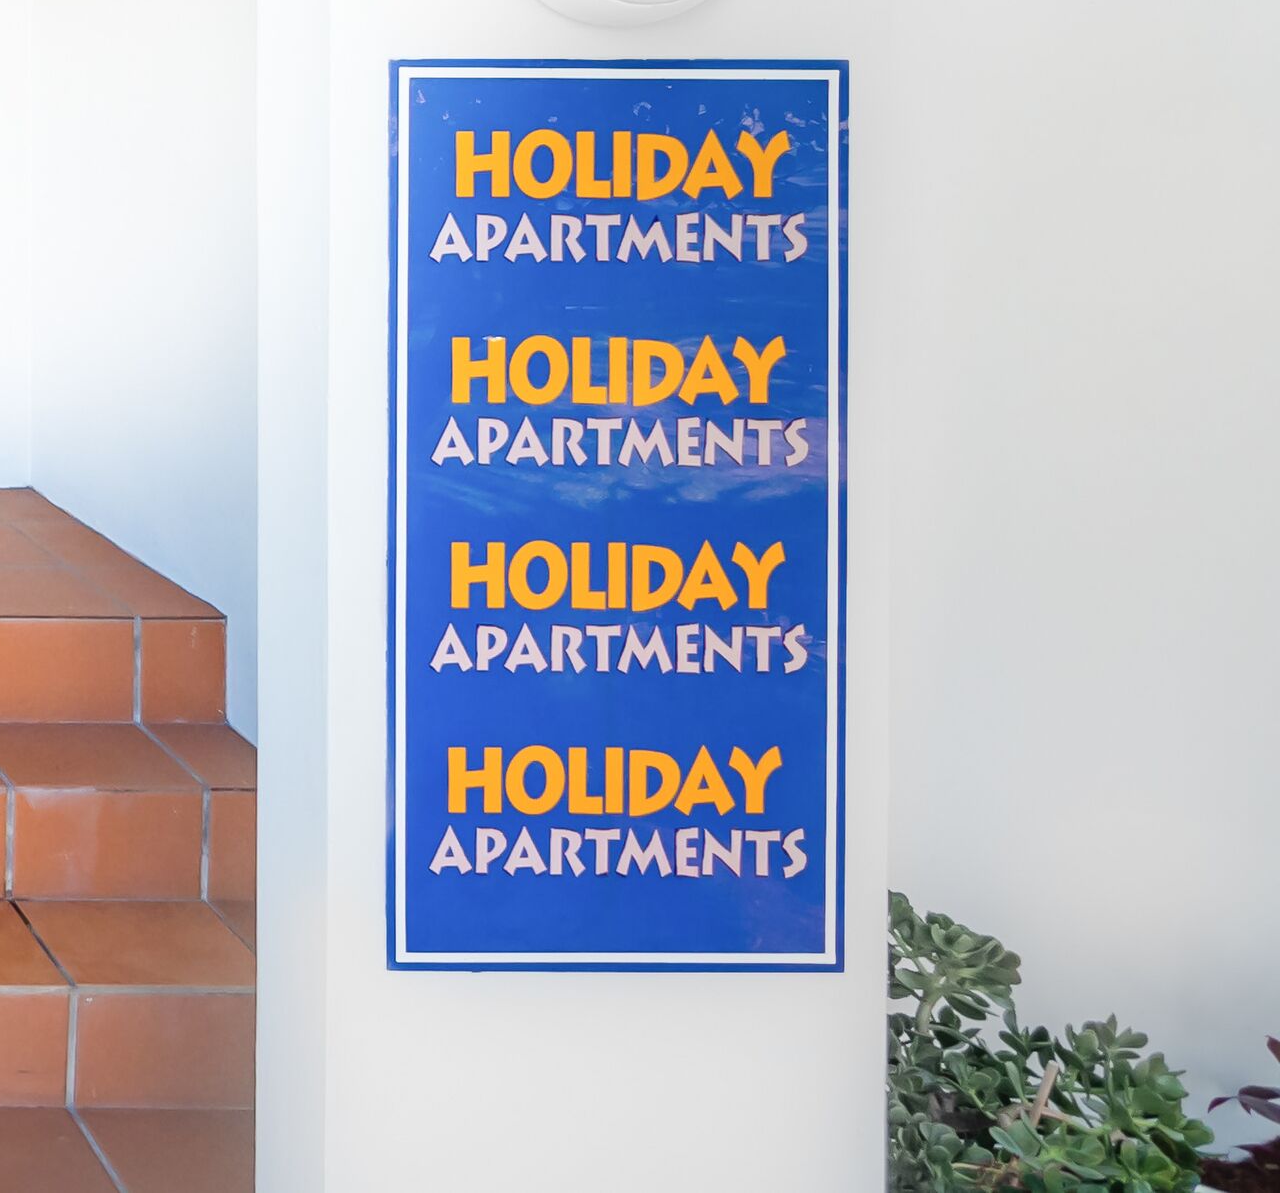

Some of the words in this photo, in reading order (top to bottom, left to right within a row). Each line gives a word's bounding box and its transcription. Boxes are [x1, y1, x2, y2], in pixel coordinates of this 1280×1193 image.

[455, 129, 792, 200] HOLIDAY
[429, 212, 808, 263] APARTMENTS
[451, 335, 787, 406] HOLIDAY
[430, 416, 809, 467] APARTMENTS
[450, 540, 786, 612] HOLIDAY
[429, 622, 808, 674] APARTMENTS
[447, 745, 783, 817] HOLIDAY
[429, 824, 808, 878] APARTMENTS
